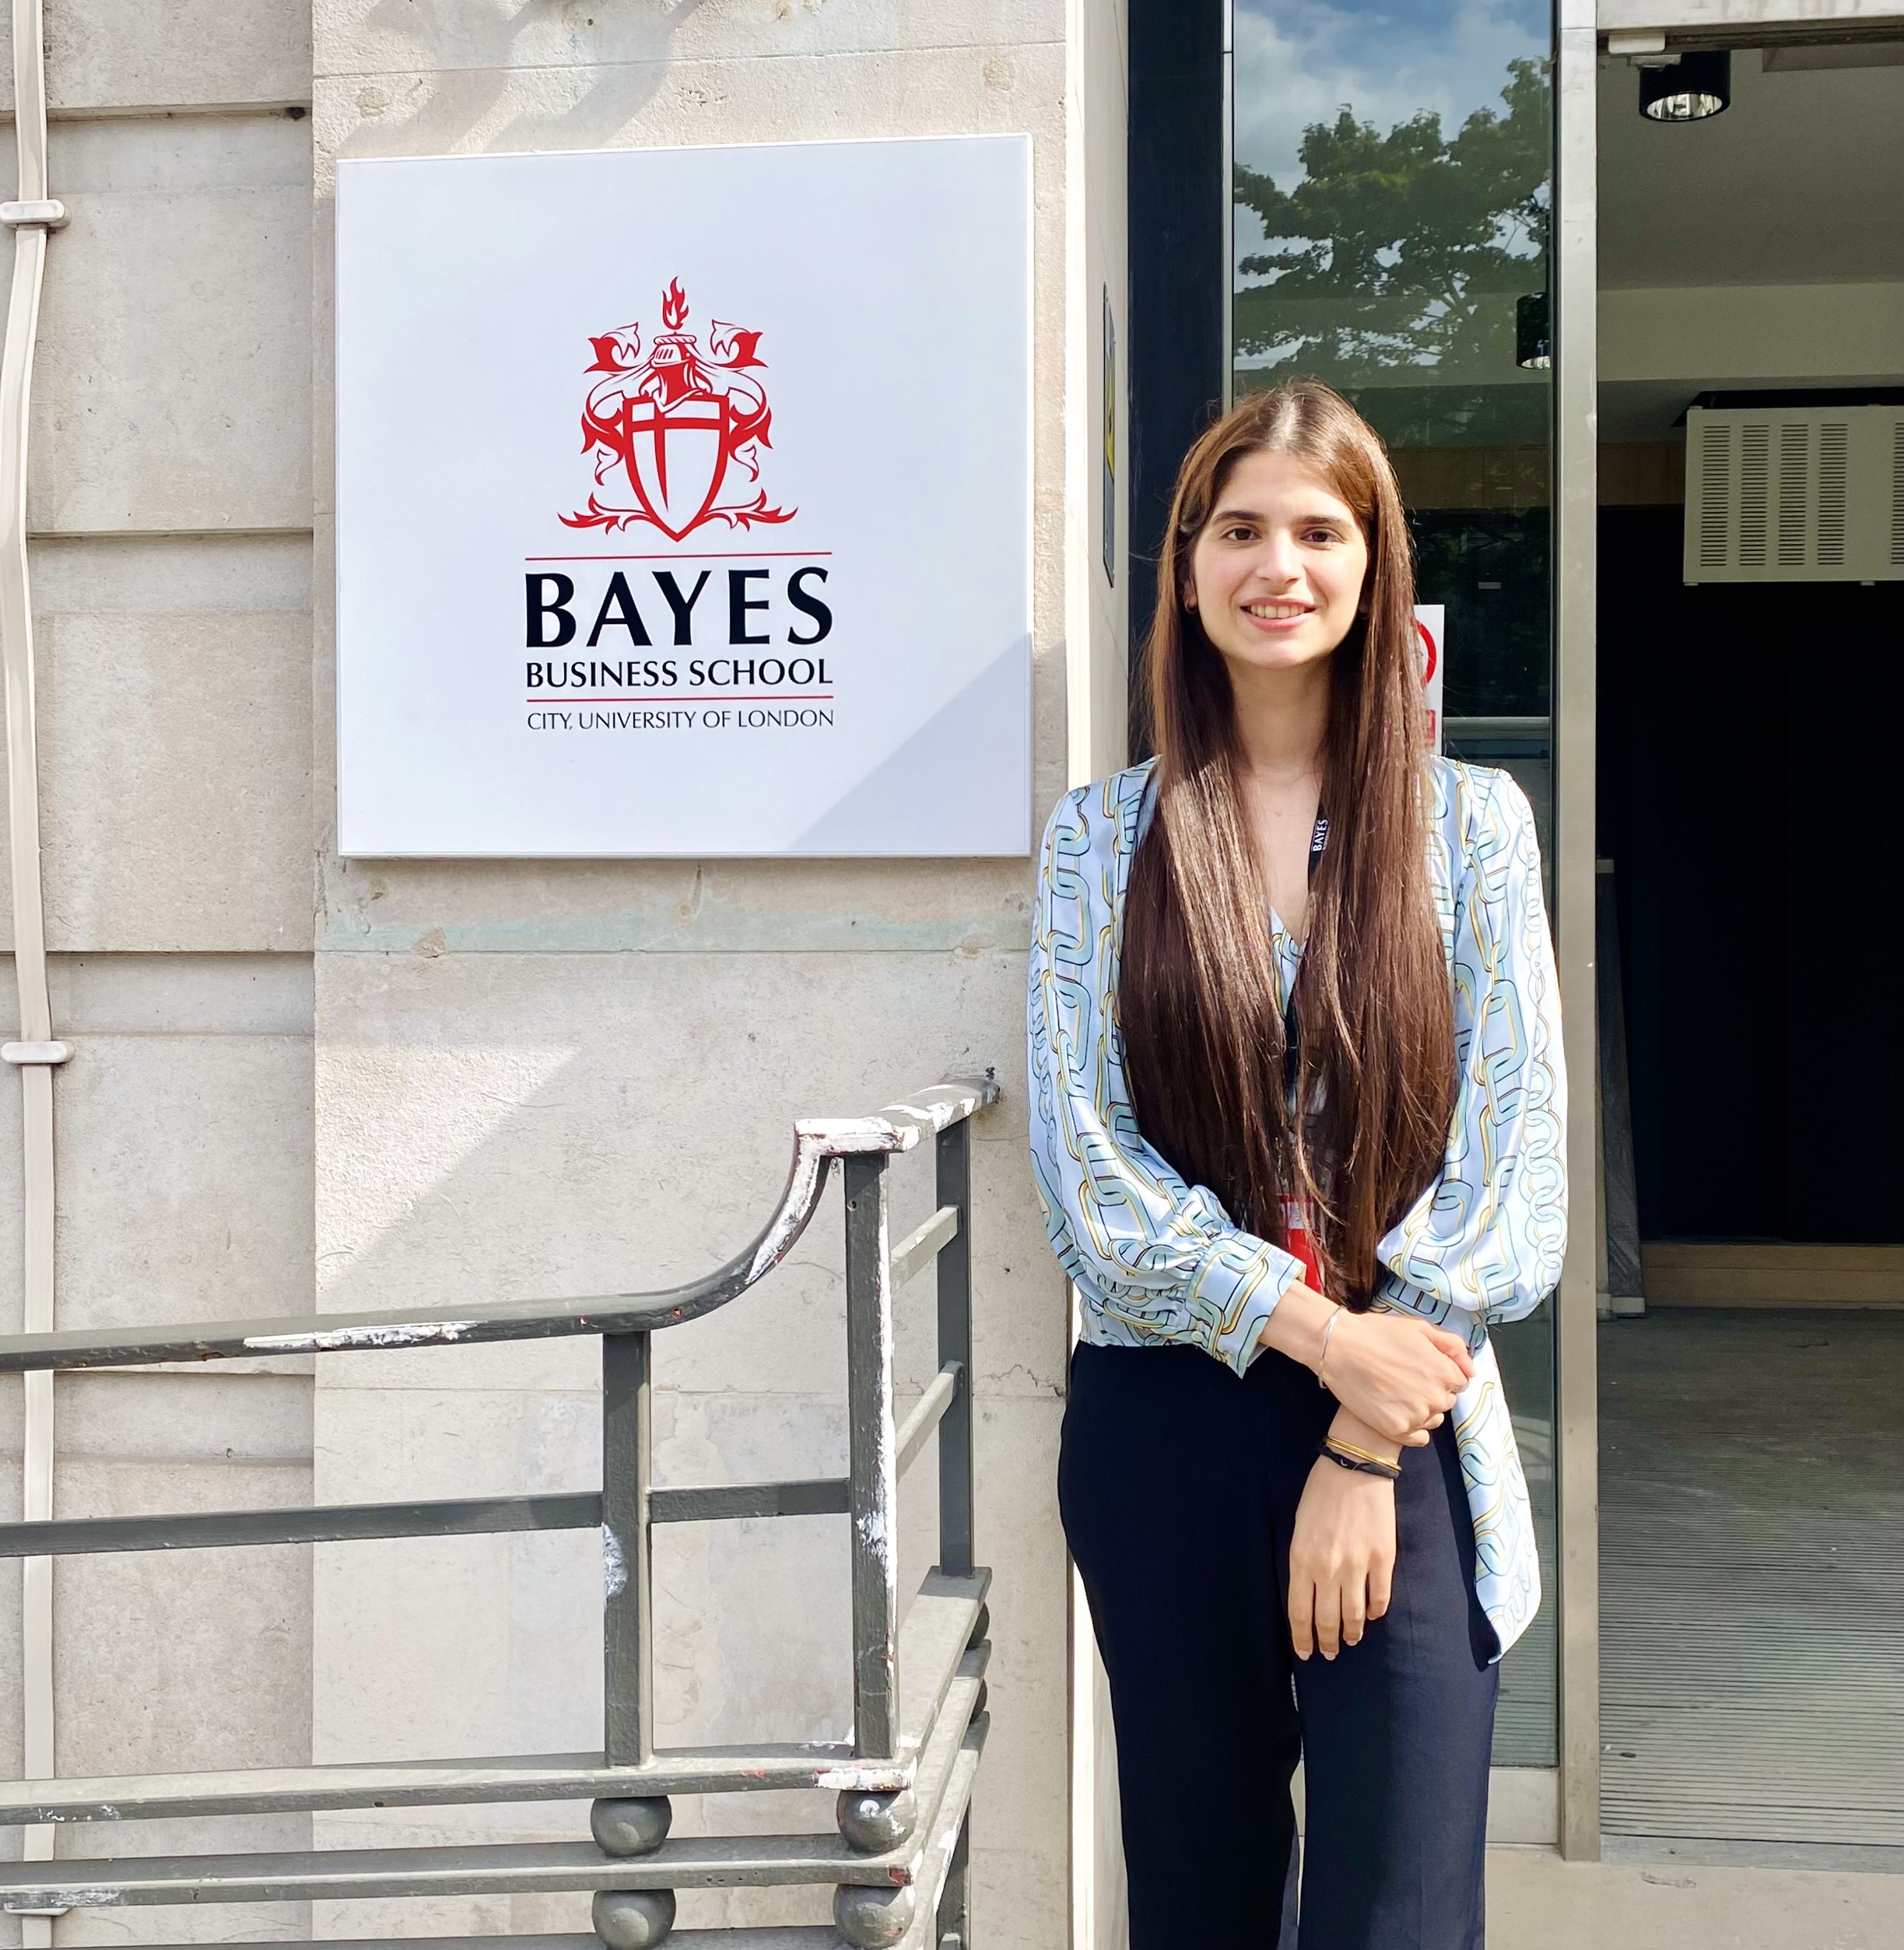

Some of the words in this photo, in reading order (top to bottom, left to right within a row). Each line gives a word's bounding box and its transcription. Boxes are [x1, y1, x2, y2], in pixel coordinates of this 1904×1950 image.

[525, 566, 833, 647] BAYES
[526, 660, 678, 688] BUSINESS
[689, 658, 833, 686] SCHOOL
[527, 712, 573, 731] CITY,
[578, 710, 697, 729] UNIVERSITY
[703, 710, 731, 728] OF
[738, 709, 833, 728] LONDON
[1312, 819, 1328, 851] BAYES
